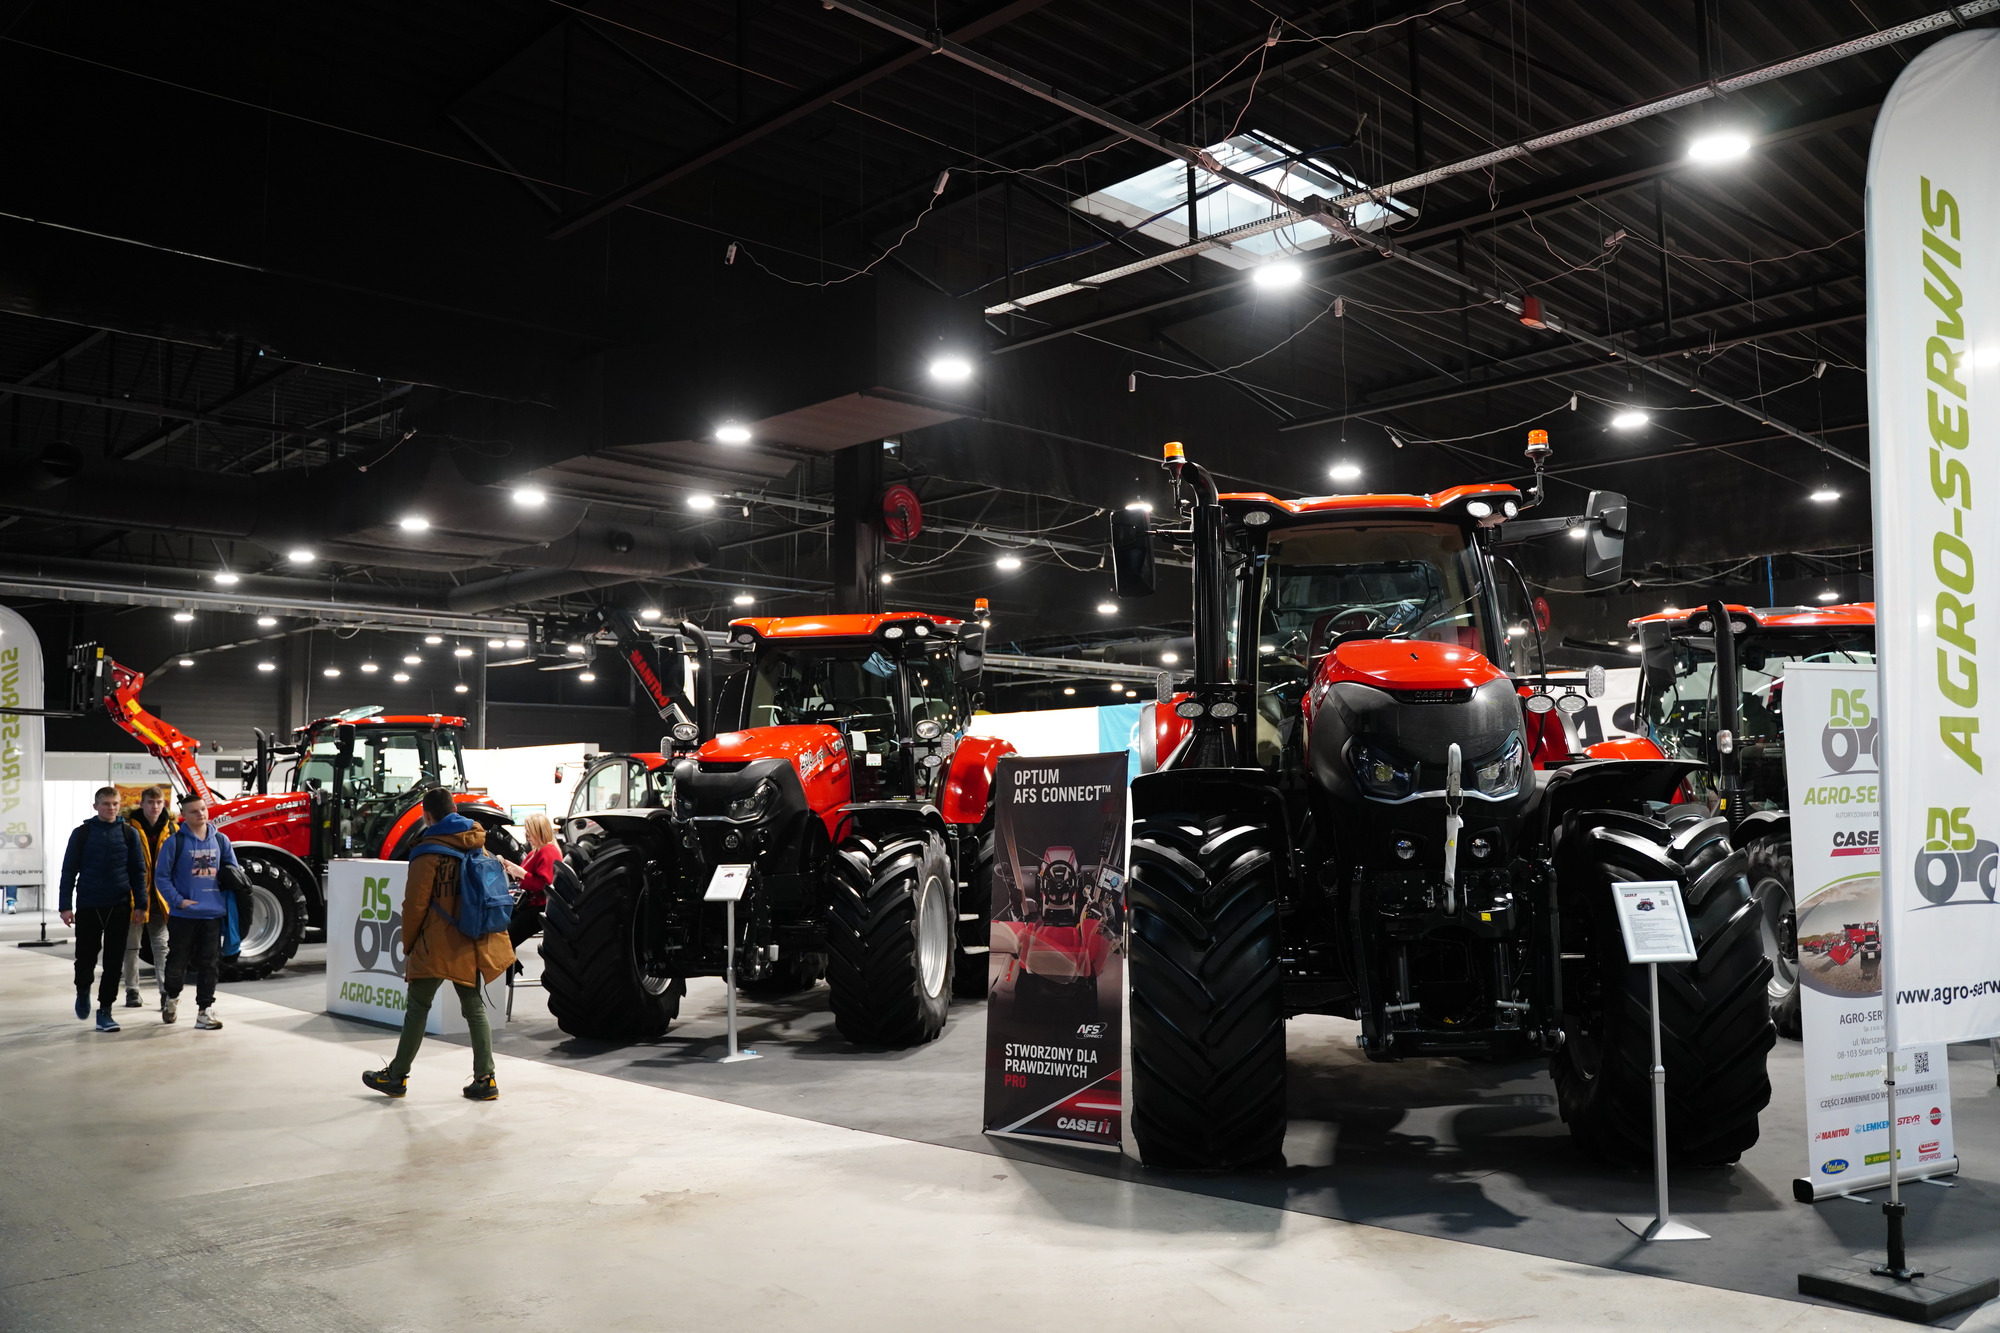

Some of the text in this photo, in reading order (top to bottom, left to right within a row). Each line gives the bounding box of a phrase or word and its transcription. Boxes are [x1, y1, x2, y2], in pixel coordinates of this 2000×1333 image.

[1920, 175, 1983, 775] AGRO-SERWIS
[630, 649, 670, 707] MANITOU
[1014, 768, 1060, 786] OPTUM
[187, 765, 216, 807] MANITOU
[1013, 788, 1037, 804] AFS
[1803, 785, 1880, 806] AGRO-SE
[1833, 830, 1880, 848] CASE
[1840, 1009, 1885, 1025] AGRO-SER
[1077, 1024, 1100, 1035] AFS
[1852, 1036, 1886, 1046] ul. Warszaw
[1005, 1043, 1098, 1064] STWORZONY DLA
[1837, 1050, 1858, 1060] 08-103
[1858, 1049, 1873, 1057] Stare
[1005, 1058, 1088, 1079] PRAWDZIWYCH
[1004, 1074, 1026, 1089] PRO
[1820, 1098, 1840, 1109] CZĘŚCI
[1840, 1094, 1870, 1106] ZAMIENNE
[1870, 1092, 1880, 1100] DO
[1914, 1084, 1935, 1093] MAREK
[1057, 1117, 1097, 1132] CASE
[1896, 1114, 1920, 1126] STEYR
[1821, 1128, 1850, 1140] MANITOU
